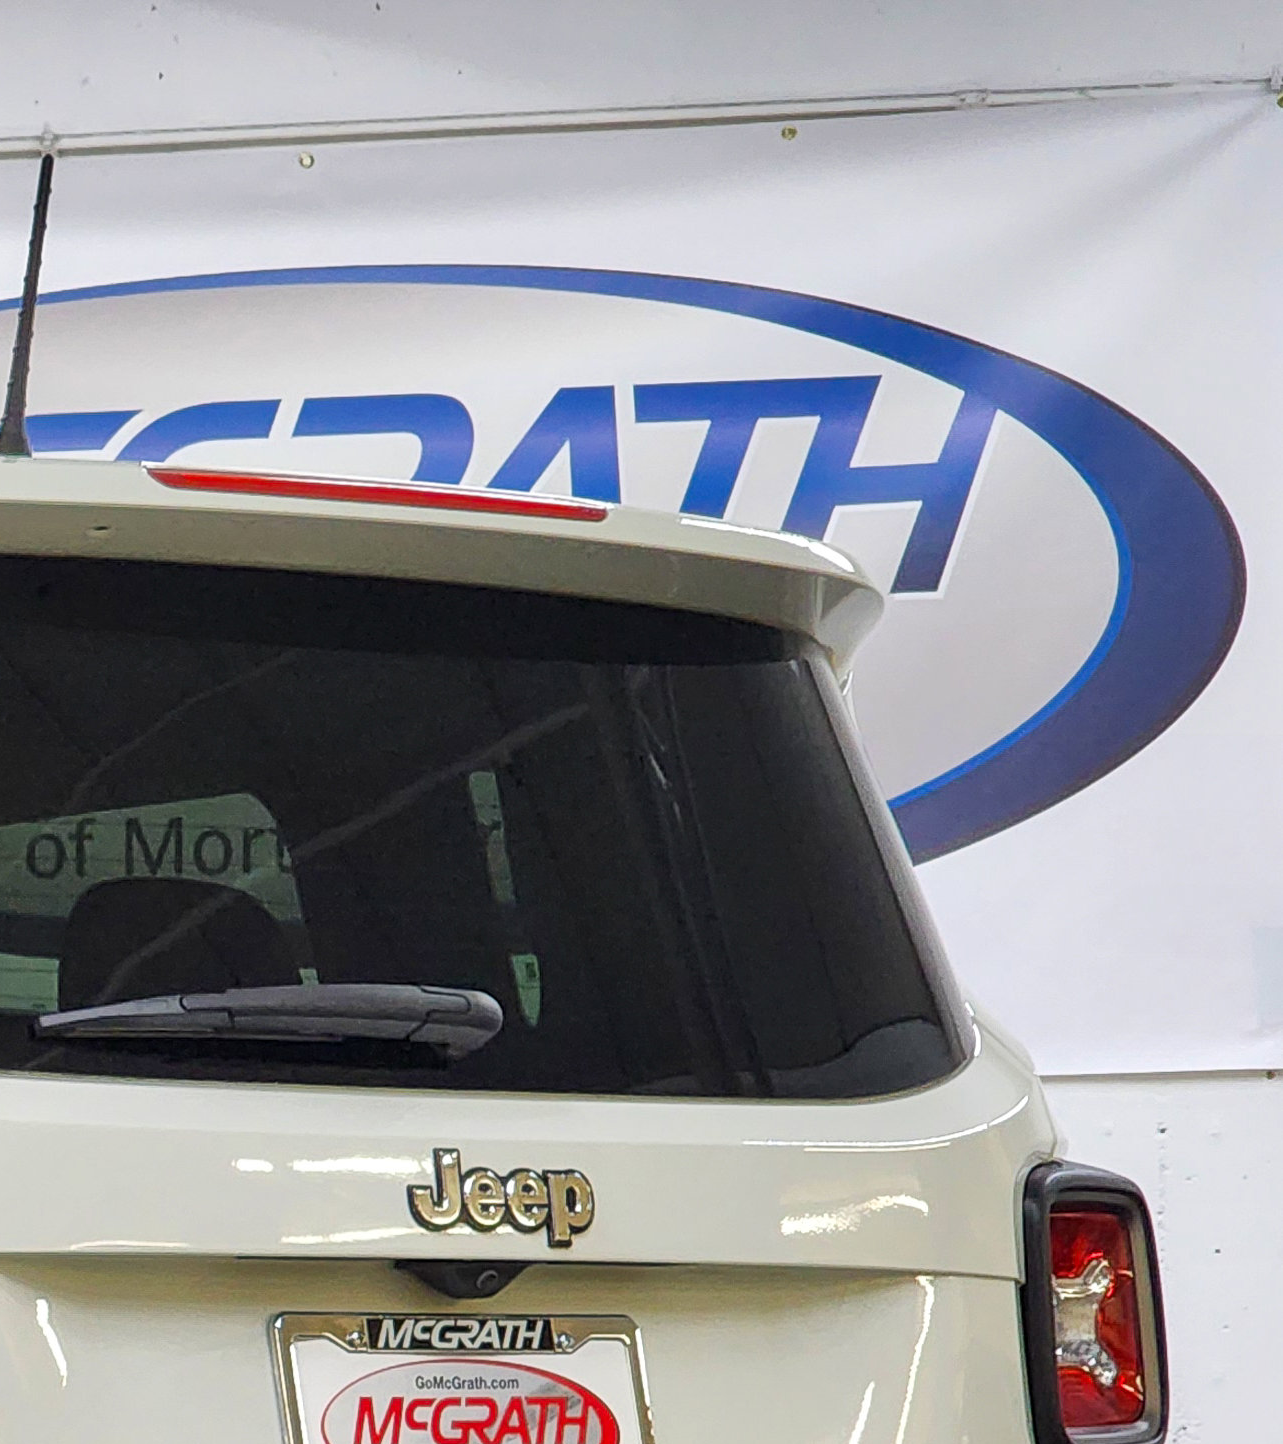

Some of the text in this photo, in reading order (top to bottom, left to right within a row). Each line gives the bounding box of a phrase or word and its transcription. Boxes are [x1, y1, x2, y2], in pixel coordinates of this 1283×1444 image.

[26, 818, 96, 879] of
[406, 1148, 595, 1248] Jeep
[414, 1376, 520, 1391] GoMcGrath.com
